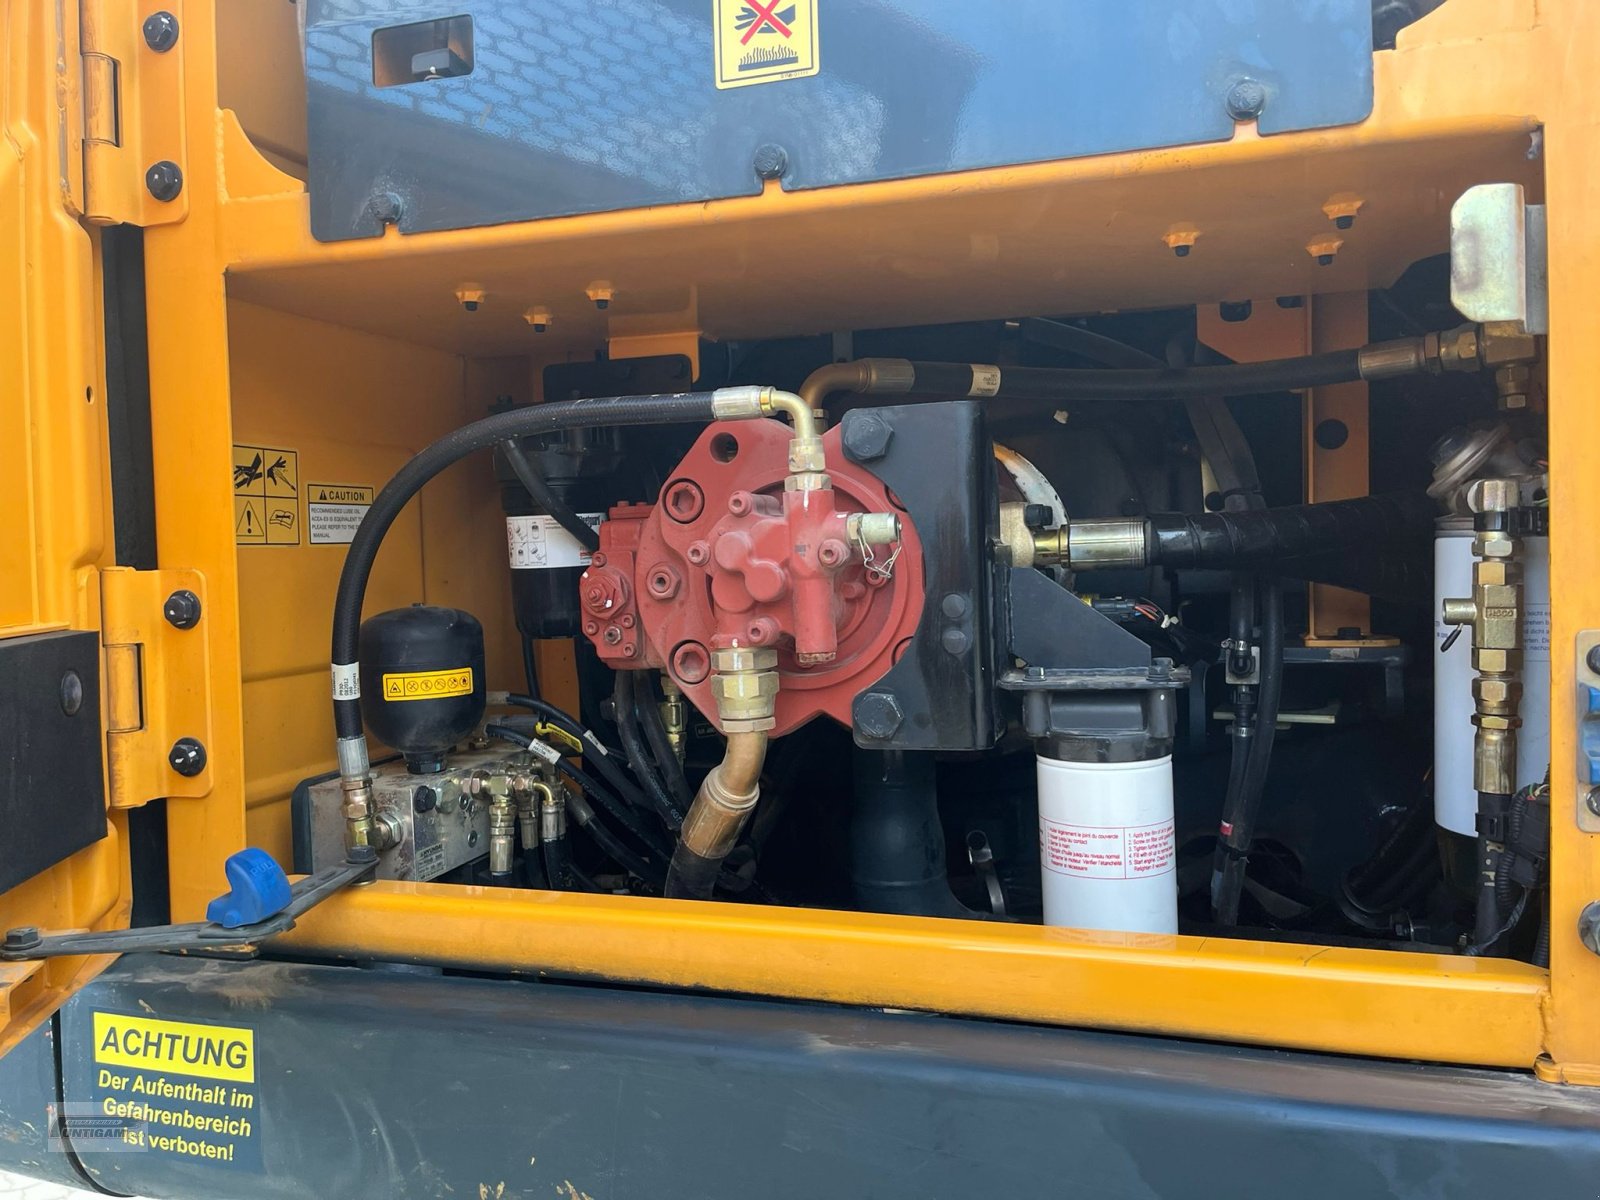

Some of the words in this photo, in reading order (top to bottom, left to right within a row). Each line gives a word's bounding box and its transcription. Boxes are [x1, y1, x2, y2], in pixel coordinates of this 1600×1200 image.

[329, 490, 365, 501] CAUTION
[100, 1026, 248, 1069] ACHTUNG
[98, 1069, 129, 1090] Der
[132, 1074, 226, 1105] Aufenthalt
[230, 1088, 254, 1109] im
[103, 1098, 252, 1137] Gefahrenbereich
[122, 1127, 145, 1146] ist
[149, 1134, 234, 1162] verboten!
